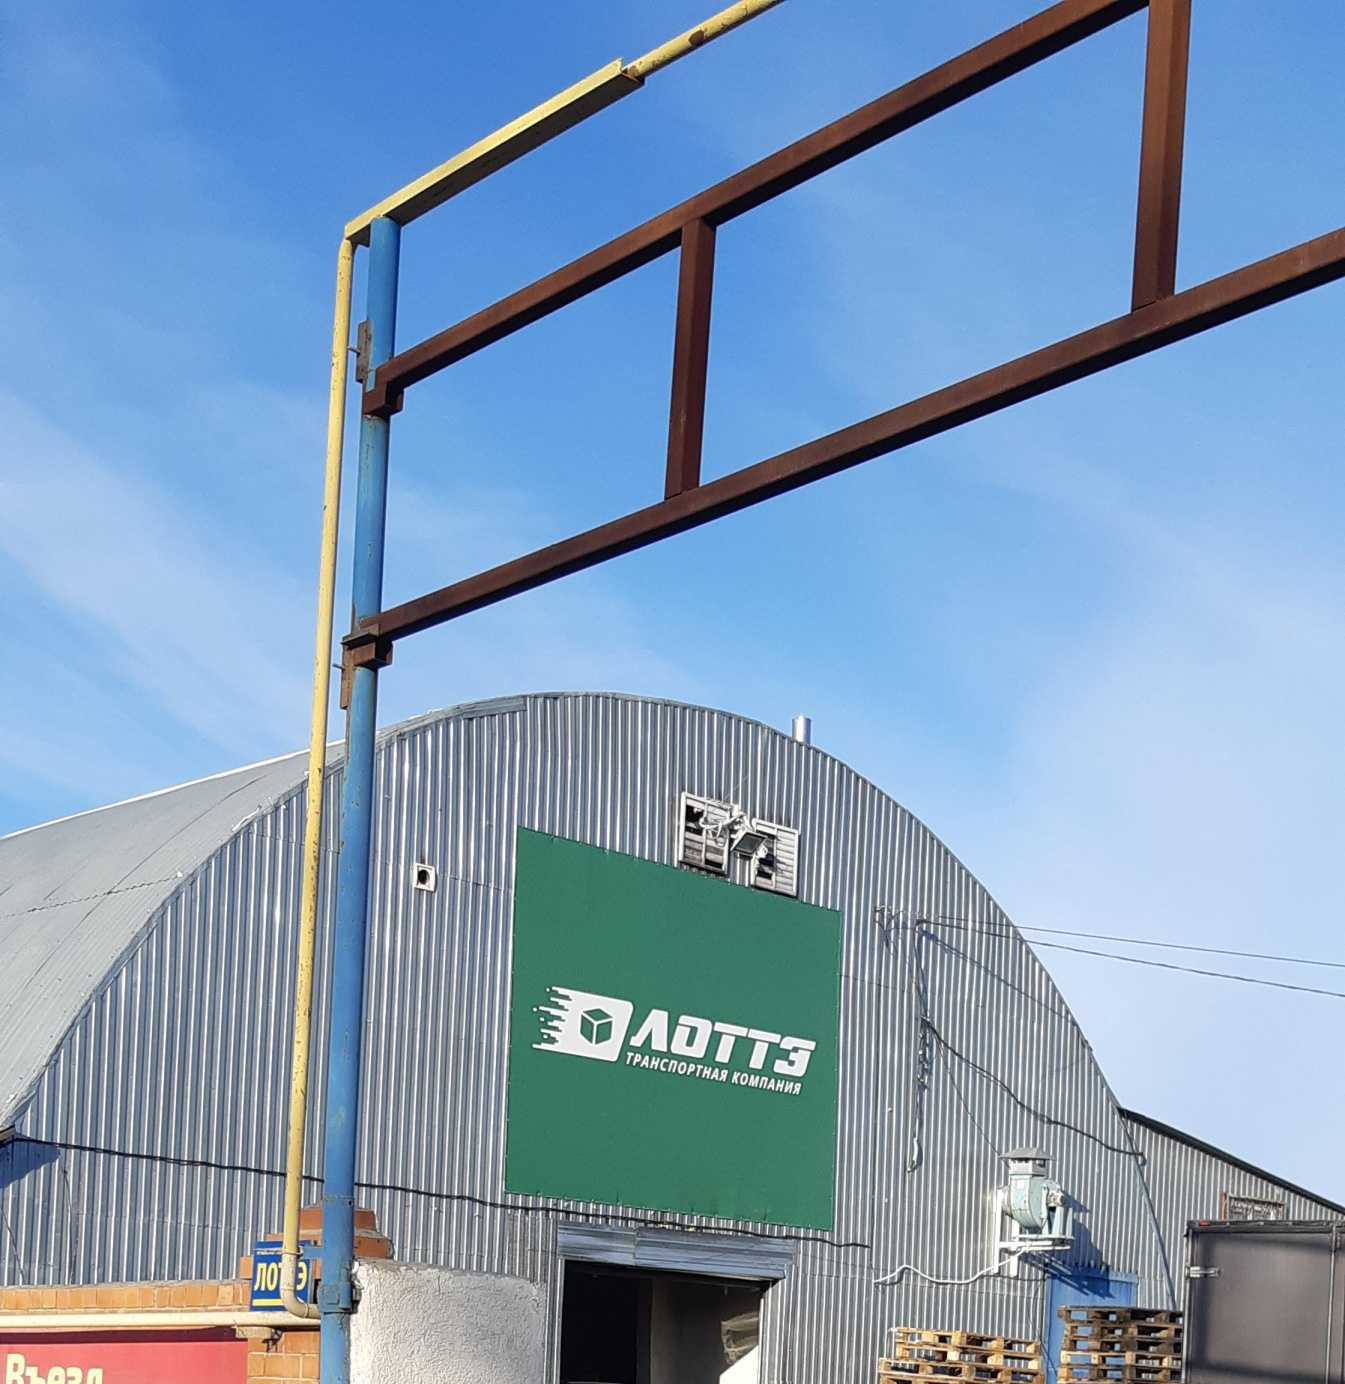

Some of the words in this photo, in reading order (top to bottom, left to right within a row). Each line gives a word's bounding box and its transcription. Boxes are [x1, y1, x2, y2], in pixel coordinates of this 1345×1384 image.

[629, 1008, 817, 1078] ЛОТТЭ
[625, 1051, 729, 1083] ТРАНСПОРТНАЯ
[731, 1071, 802, 1096] КОМПАНИЯ
